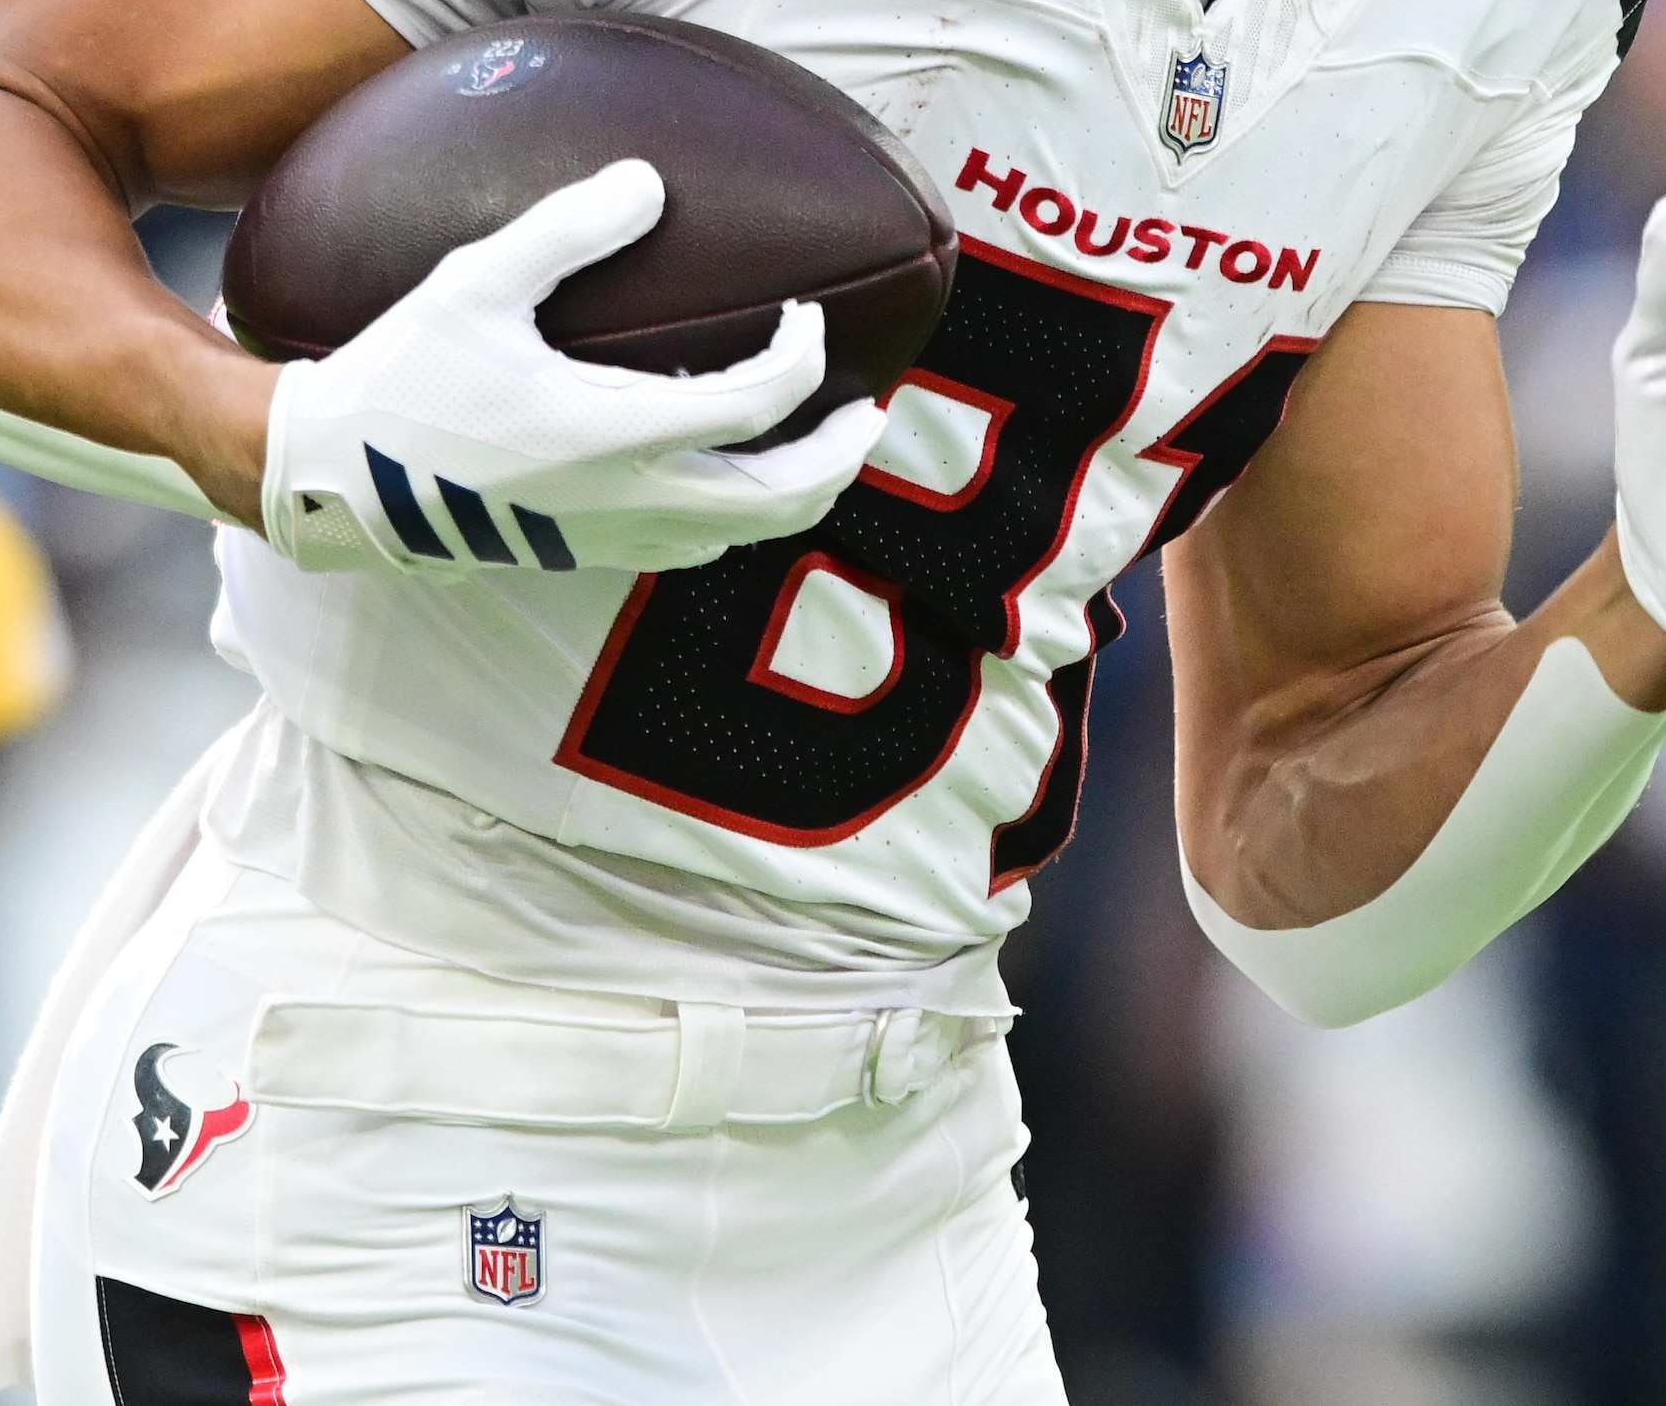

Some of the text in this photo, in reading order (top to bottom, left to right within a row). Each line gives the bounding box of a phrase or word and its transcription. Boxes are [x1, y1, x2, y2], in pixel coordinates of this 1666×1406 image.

[1170, 96, 1215, 140] NFL
[954, 147, 1321, 292] HOUSTON
[553, 232, 1325, 898] 81
[478, 1249, 535, 1295] NFL
